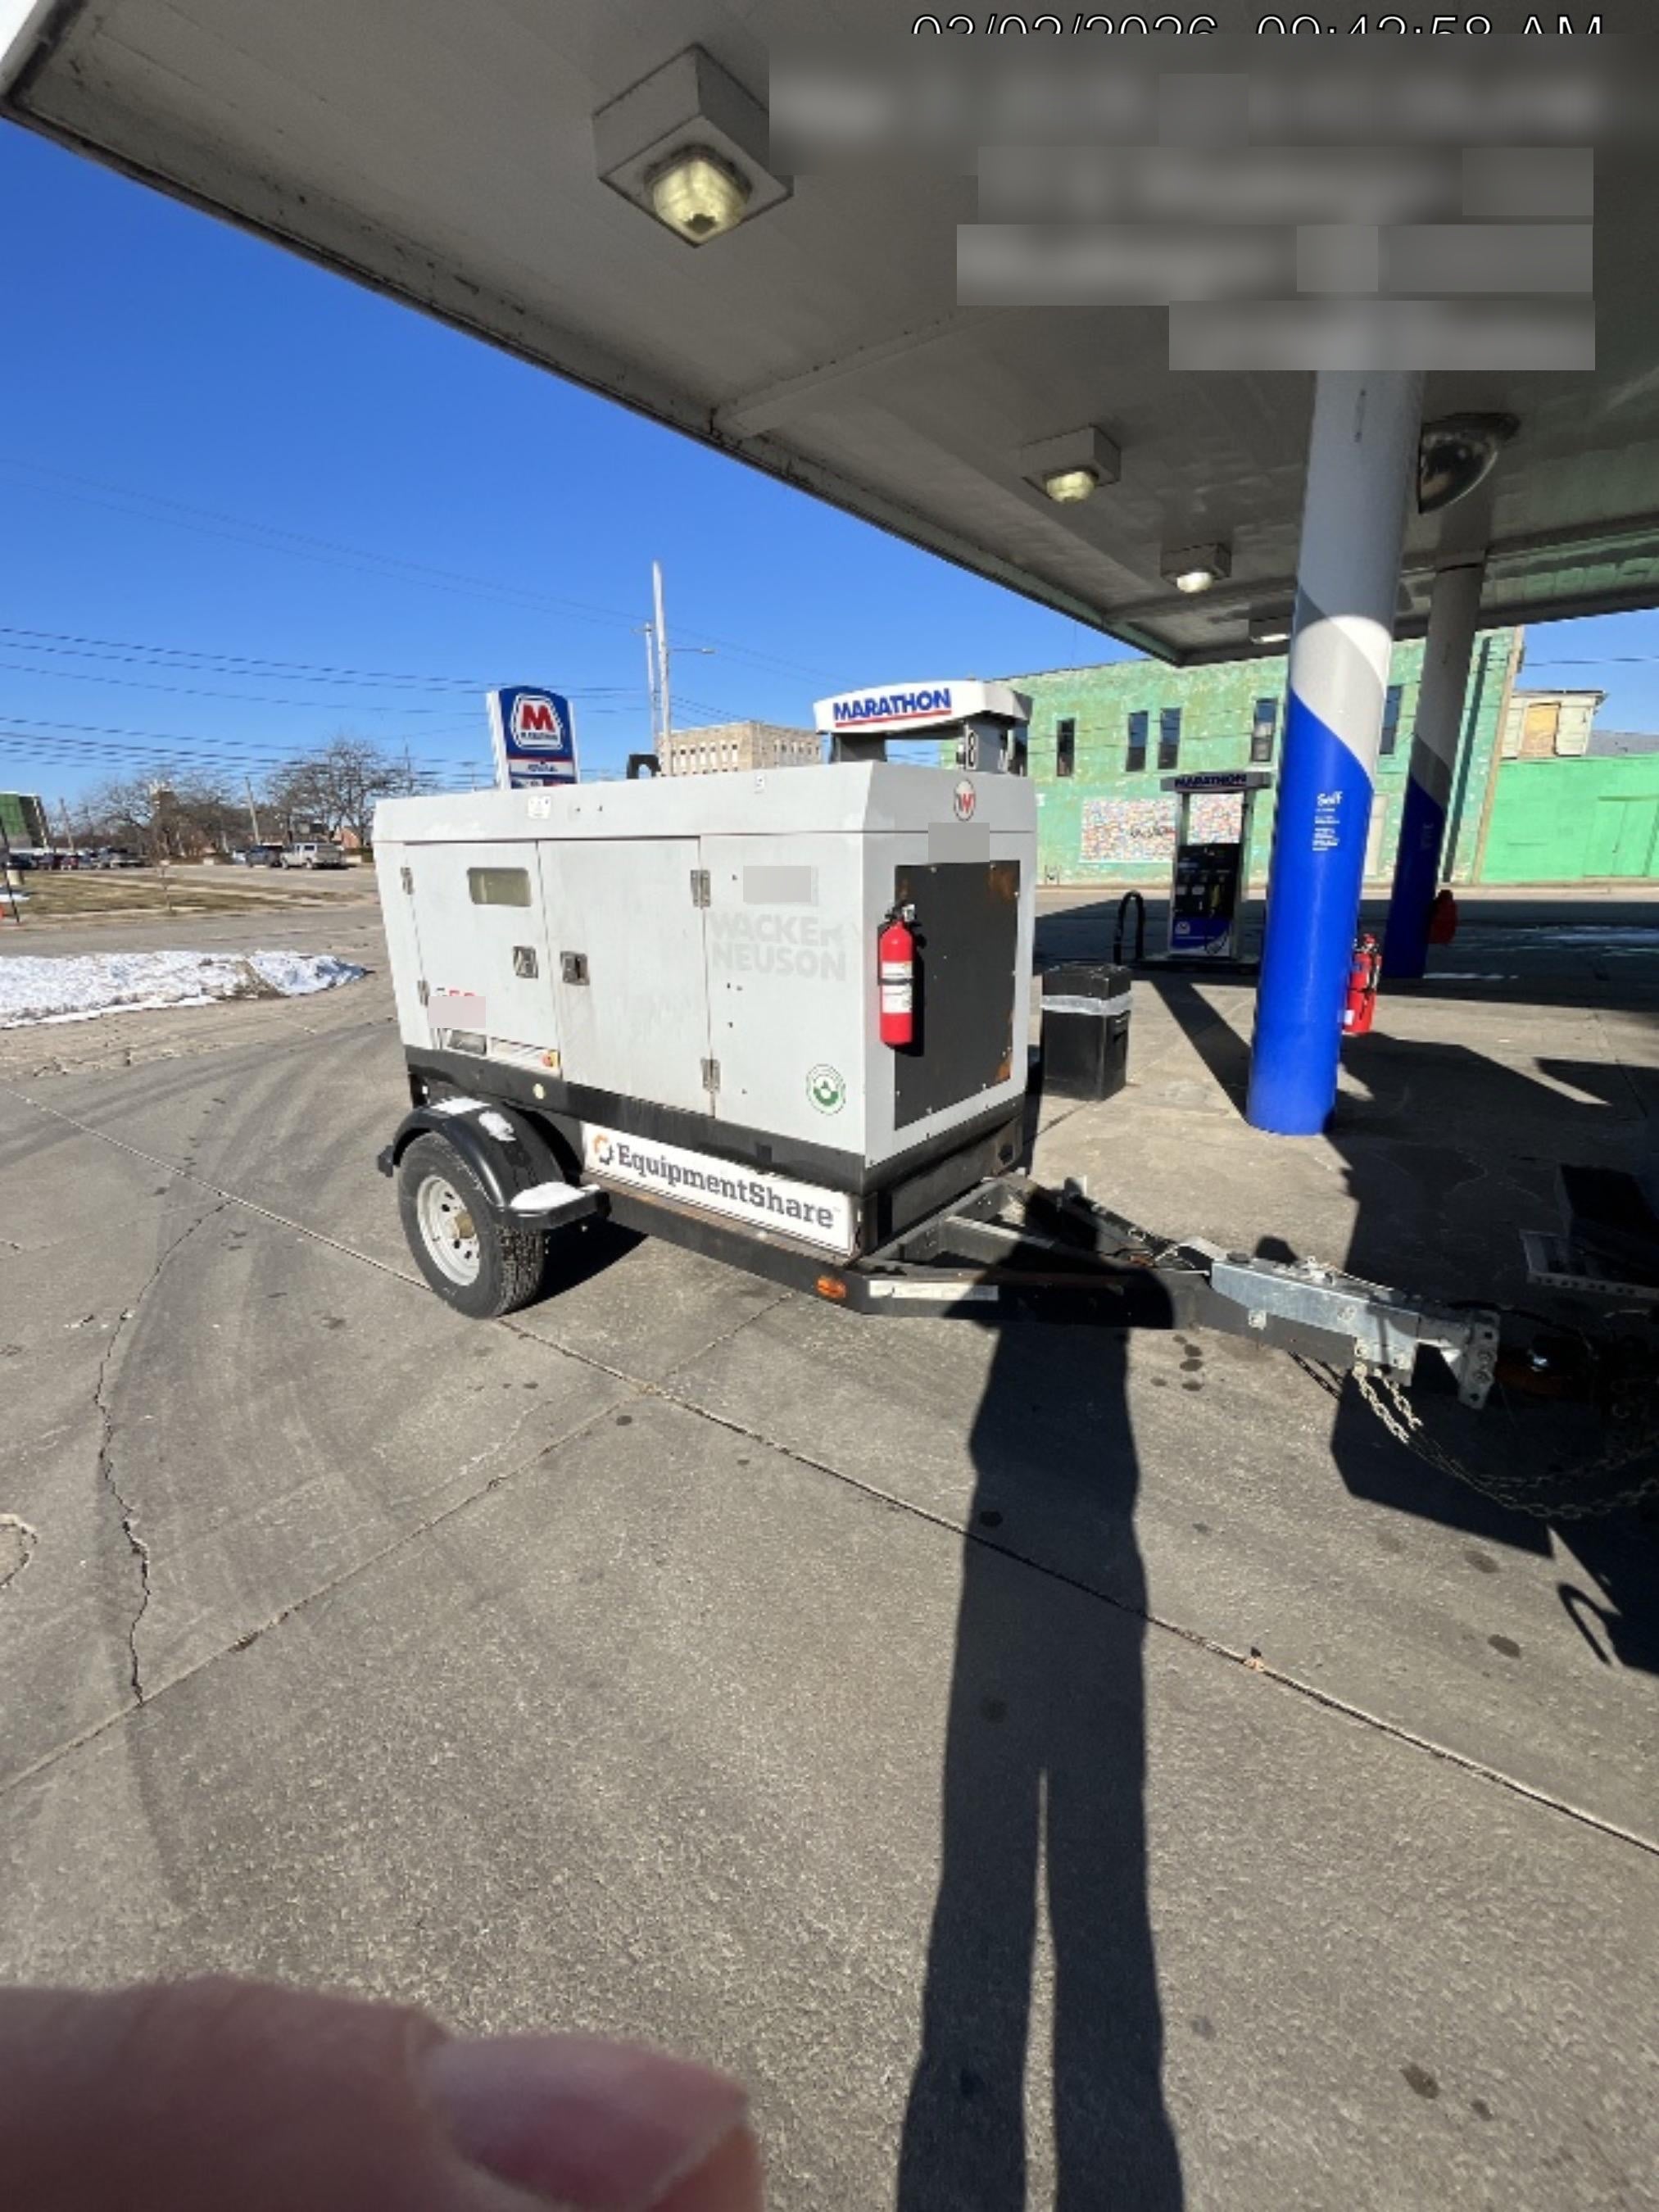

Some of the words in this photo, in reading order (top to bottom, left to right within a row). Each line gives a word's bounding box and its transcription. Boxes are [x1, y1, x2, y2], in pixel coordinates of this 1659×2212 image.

[521, 704, 556, 733] M
[832, 687, 952, 721] MARATHON
[712, 942, 846, 981] NEUSON
[617, 1142, 835, 1228] EquipmentShare
